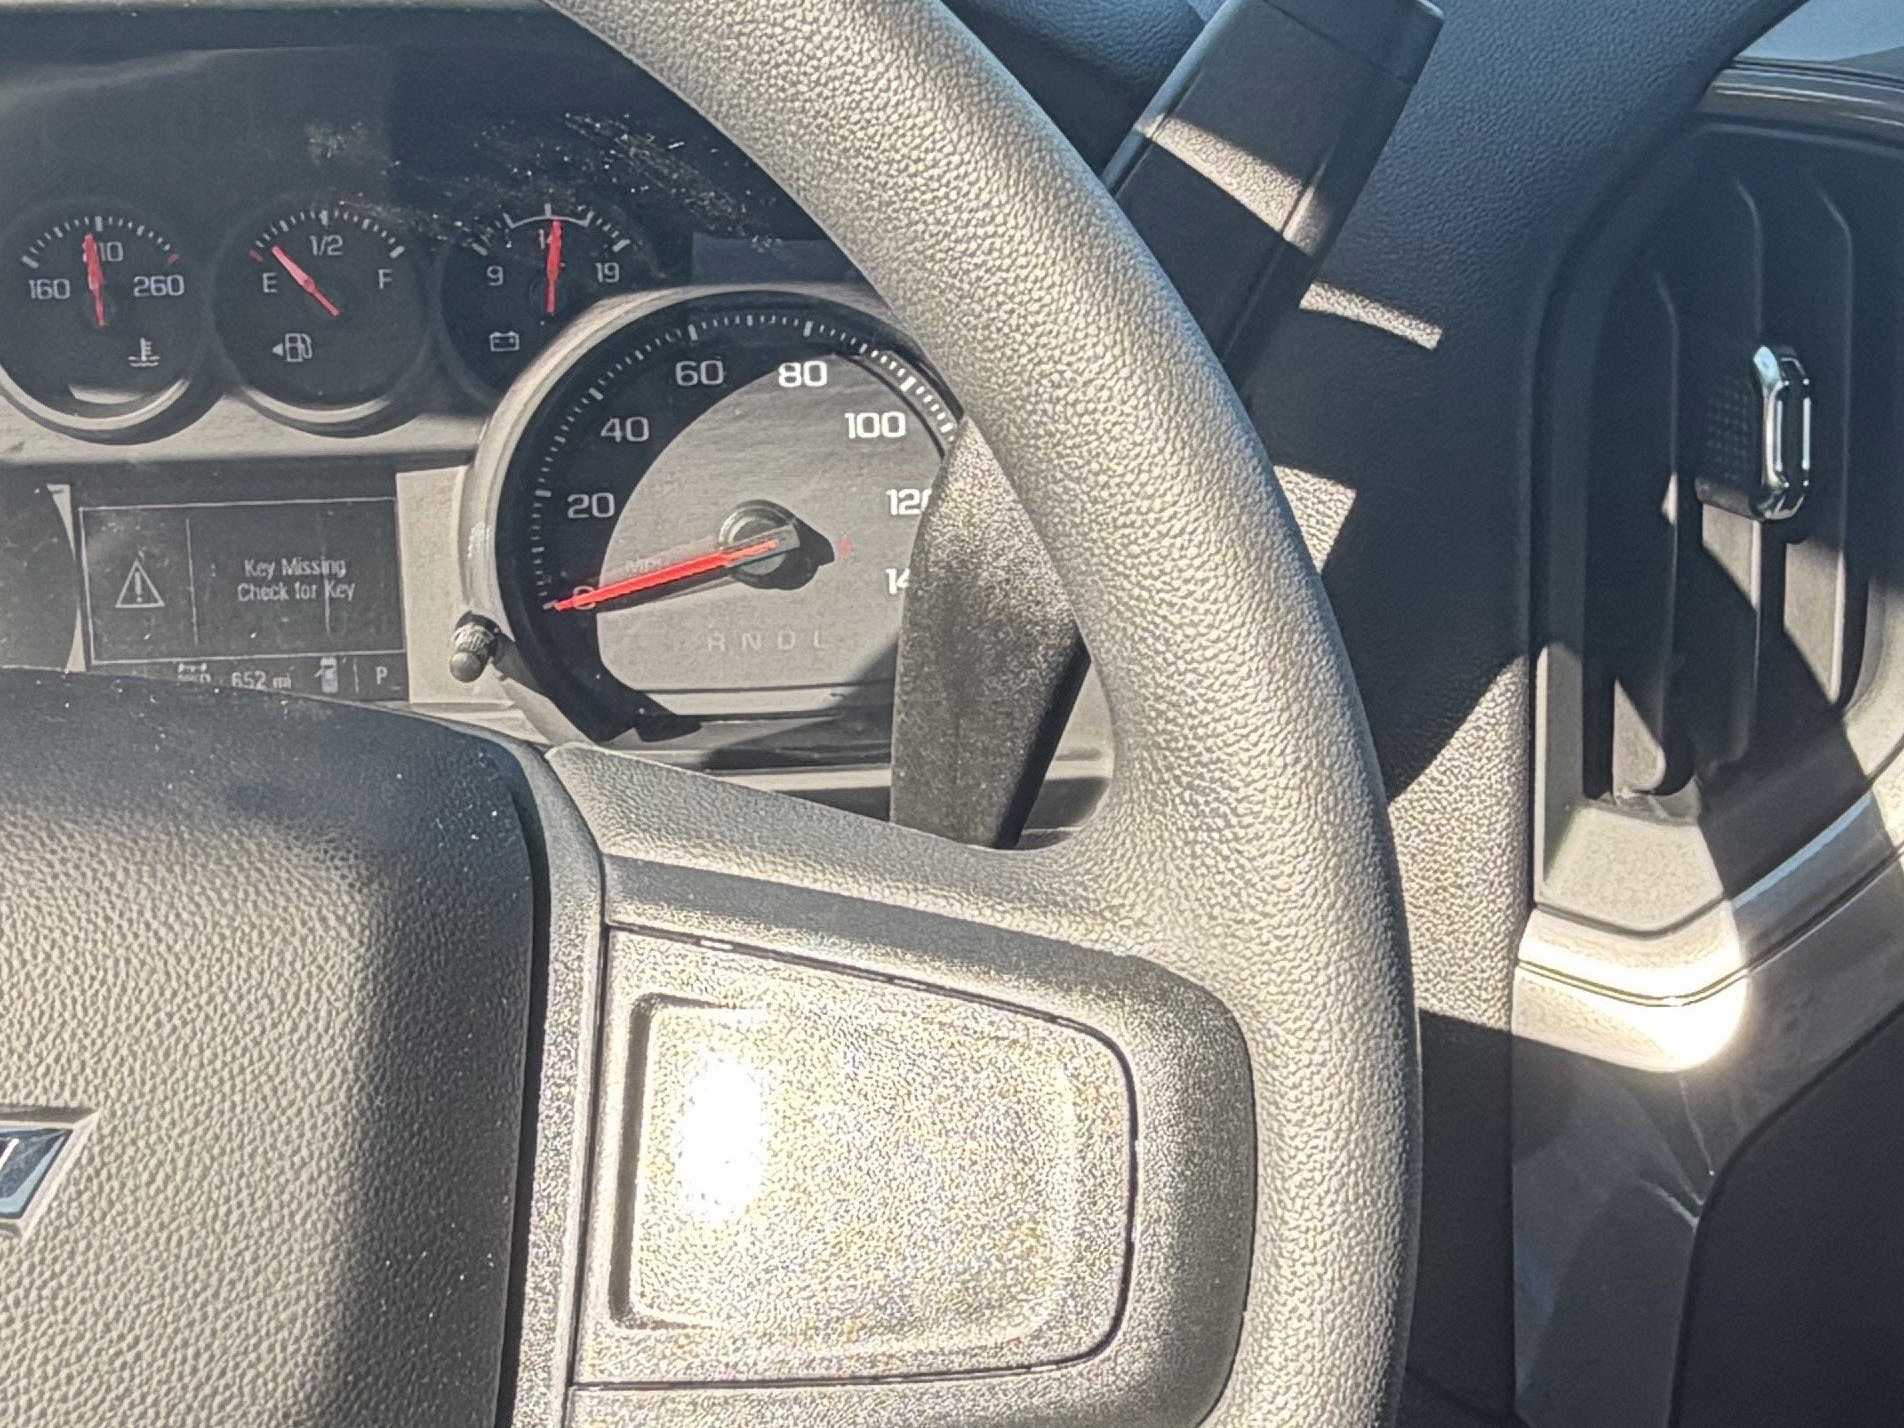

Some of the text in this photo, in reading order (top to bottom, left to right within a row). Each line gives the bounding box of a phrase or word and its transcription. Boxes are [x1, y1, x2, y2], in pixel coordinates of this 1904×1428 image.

[309, 234, 345, 257] 1/2
[262, 272, 278, 294] E
[377, 269, 395, 290] F
[486, 266, 504, 287] 9
[595, 262, 621, 284] 19
[29, 278, 70, 300] 160
[133, 274, 185, 298] 260
[675, 360, 725, 387] 60
[778, 360, 828, 388] 80
[600, 416, 650, 443] 40
[845, 411, 907, 440] 100
[567, 492, 616, 519] 20
[245, 557, 346, 579] Key Missing
[237, 579, 356, 602] Check for Key
[375, 666, 387, 685] P
